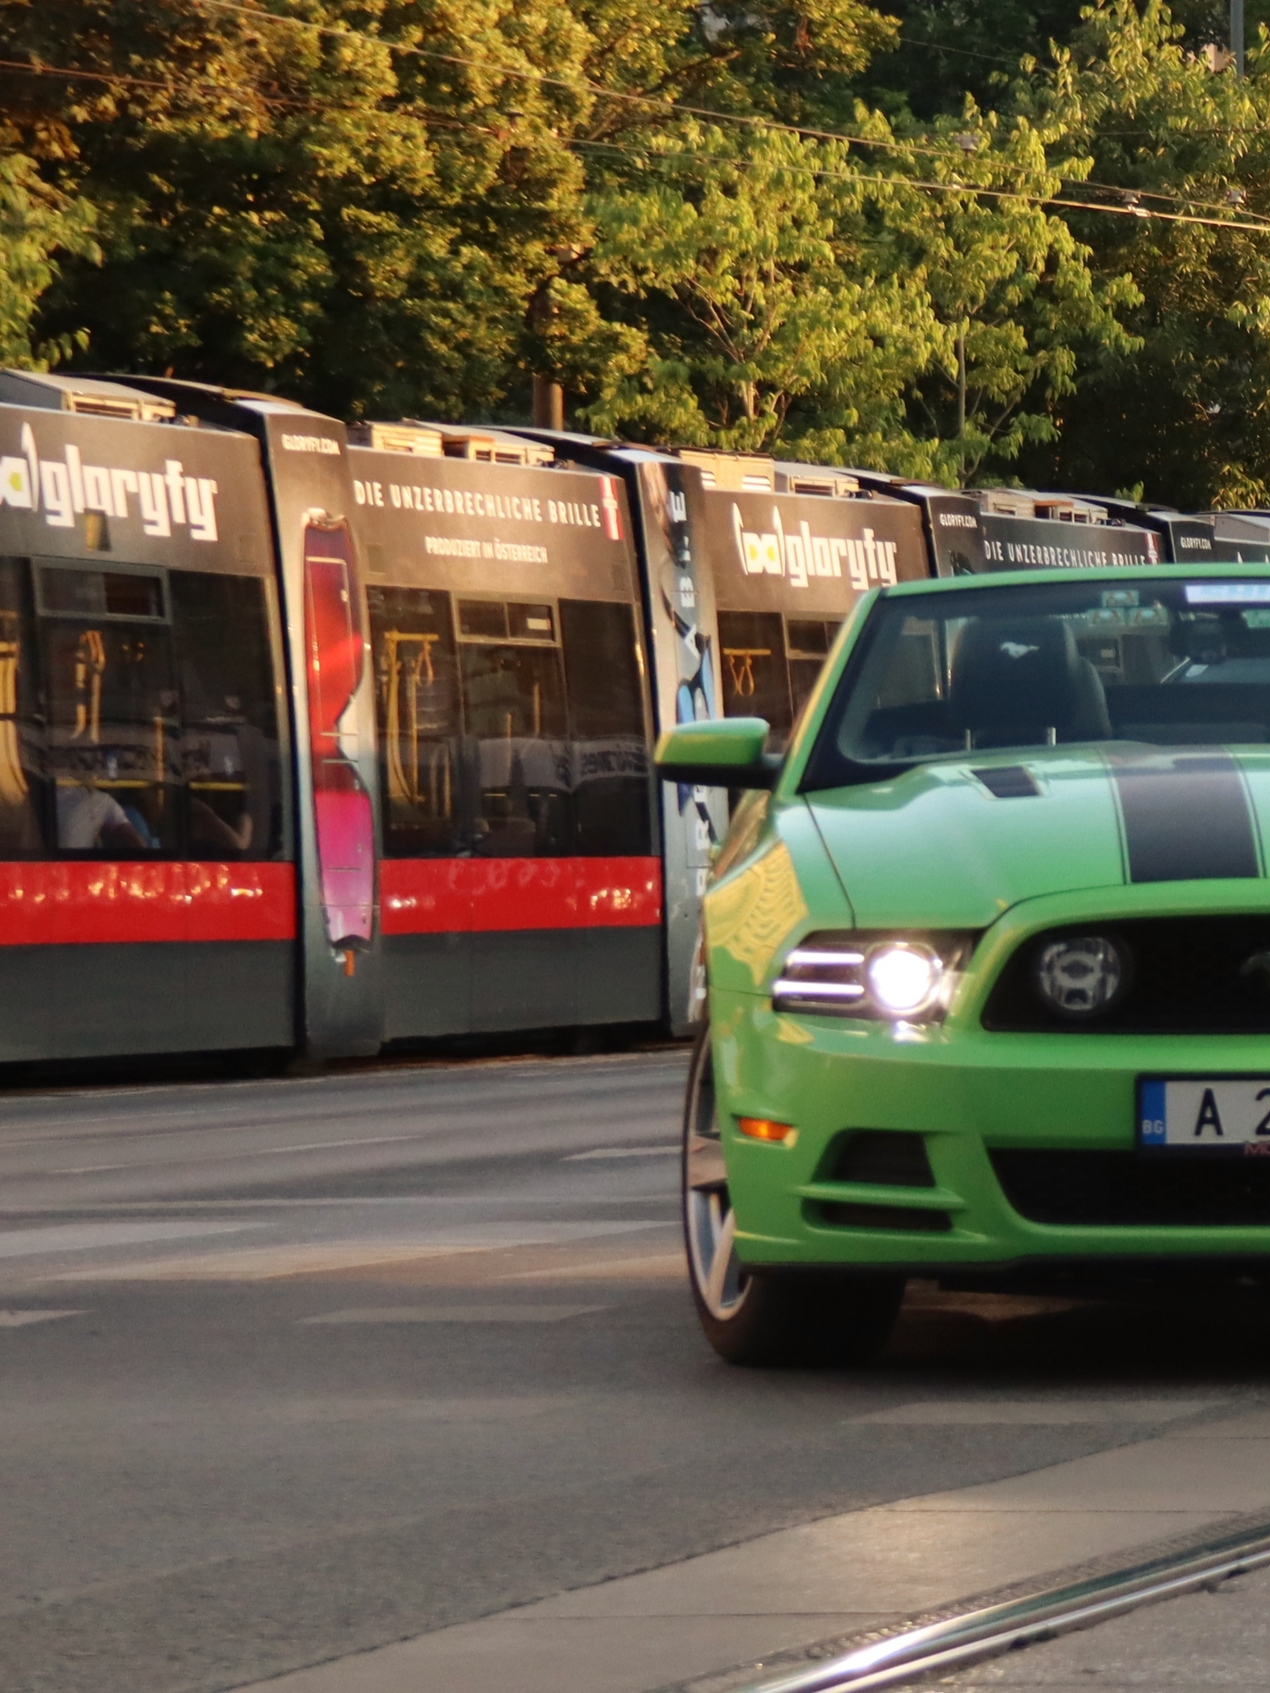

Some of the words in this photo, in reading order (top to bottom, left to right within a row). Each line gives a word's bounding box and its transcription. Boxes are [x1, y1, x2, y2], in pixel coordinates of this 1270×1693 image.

[281, 434, 341, 456] GLORYFY.COM
[353, 479, 385, 507] DIE
[389, 483, 543, 522] UNZERBRECHLICHE
[547, 499, 601, 528] BRILLE
[424, 536, 482, 559] PRODUZIERT
[482, 541, 495, 560] IN
[494, 537, 549, 564] ÖSTERREICH
[784, 519, 898, 591] gloryfy
[983, 539, 1004, 562] DIE
[1008, 542, 1107, 568] UNZERBRECHLICHE
[1142, 1119, 1165, 1134] BG
[1193, 1087, 1224, 1137] A
